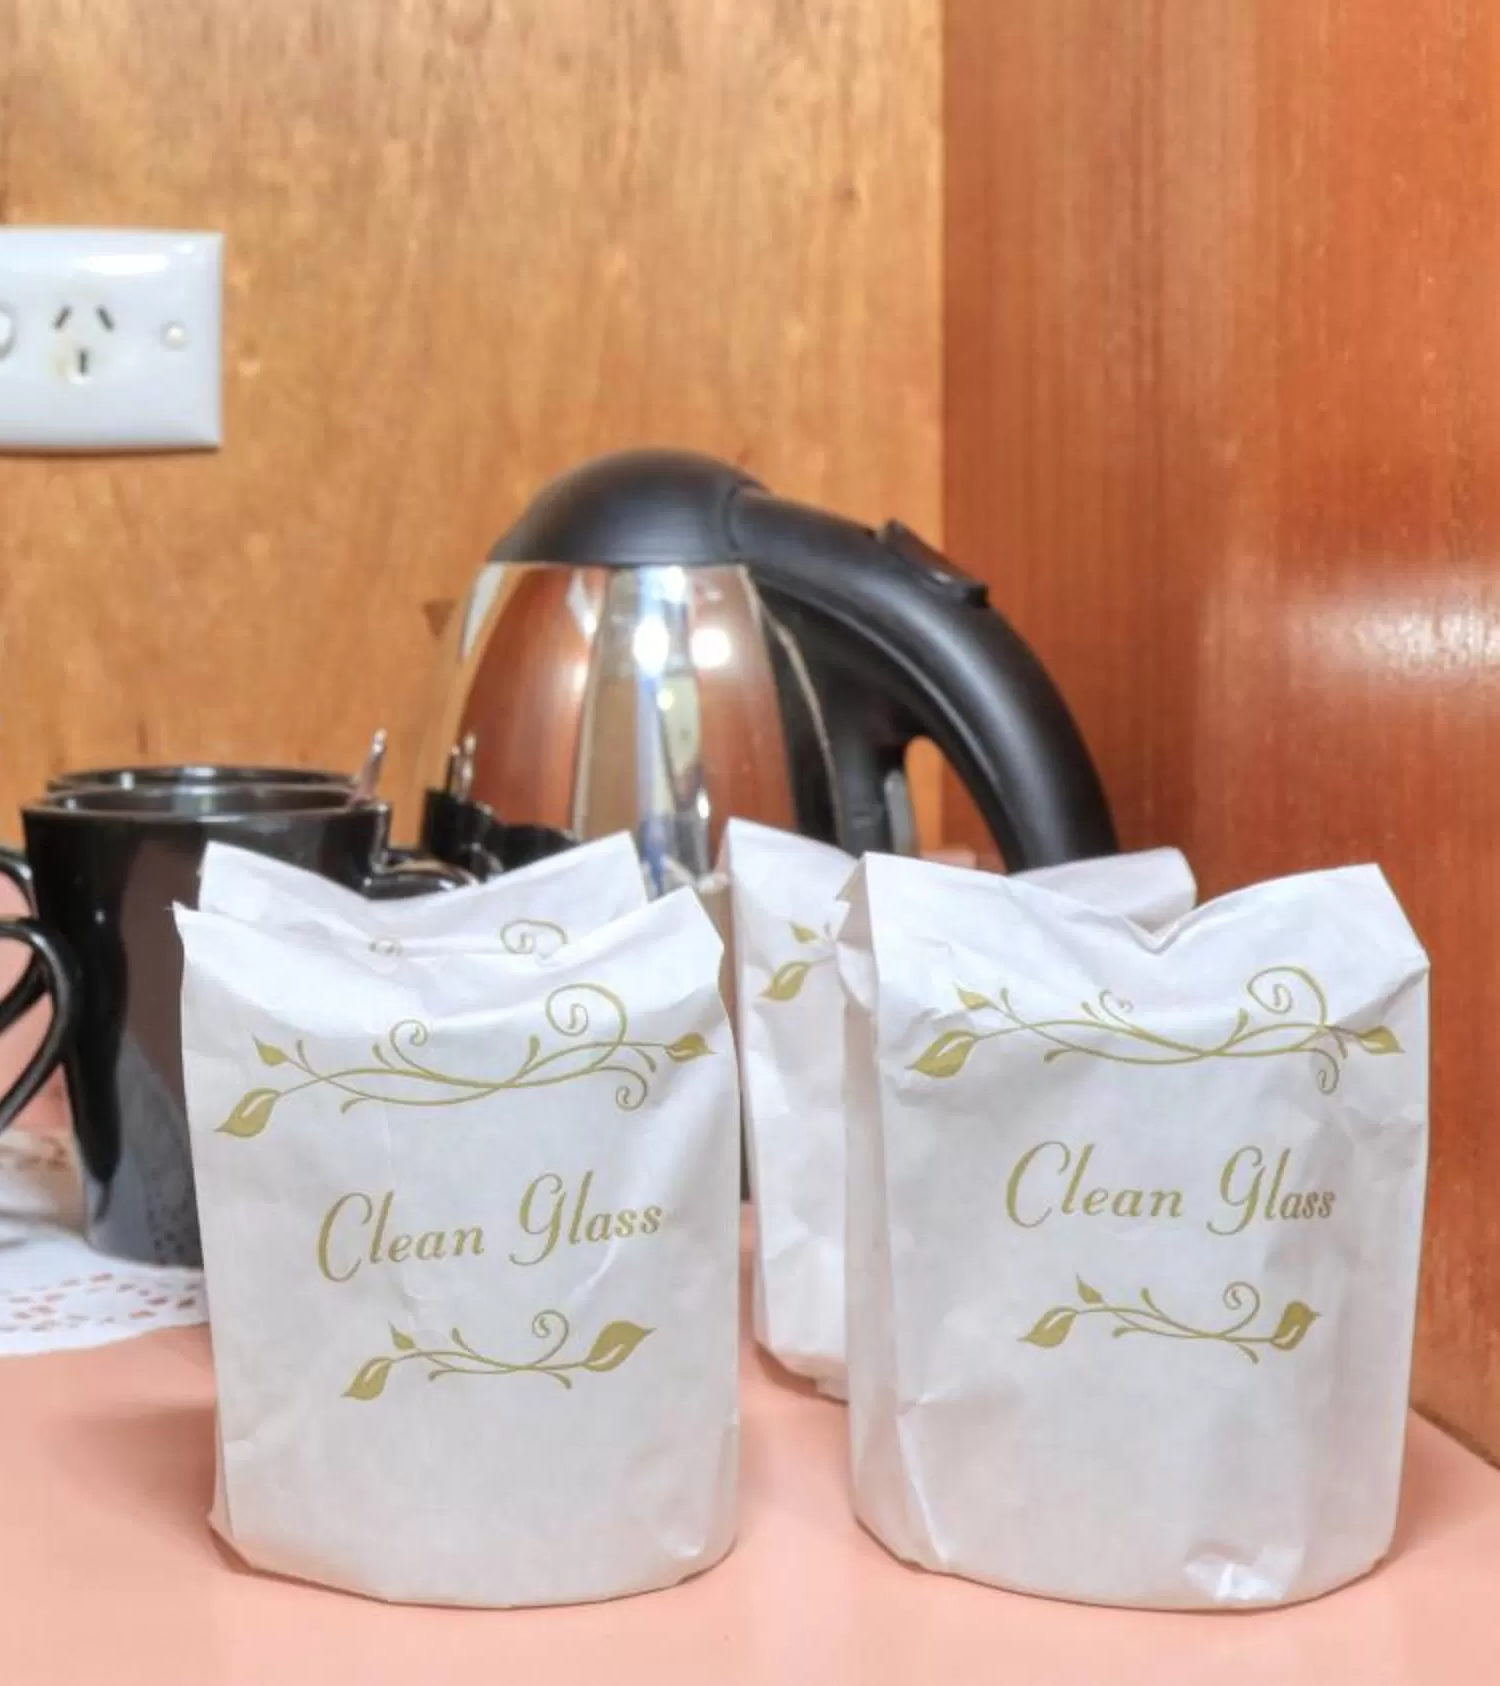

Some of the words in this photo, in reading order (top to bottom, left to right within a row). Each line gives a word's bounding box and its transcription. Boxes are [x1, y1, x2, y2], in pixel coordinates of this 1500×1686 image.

[316, 1190, 485, 1283] Clean
[508, 1169, 664, 1266] Glass
[1005, 1140, 1183, 1228] Clean
[1206, 1144, 1336, 1236] Glass
